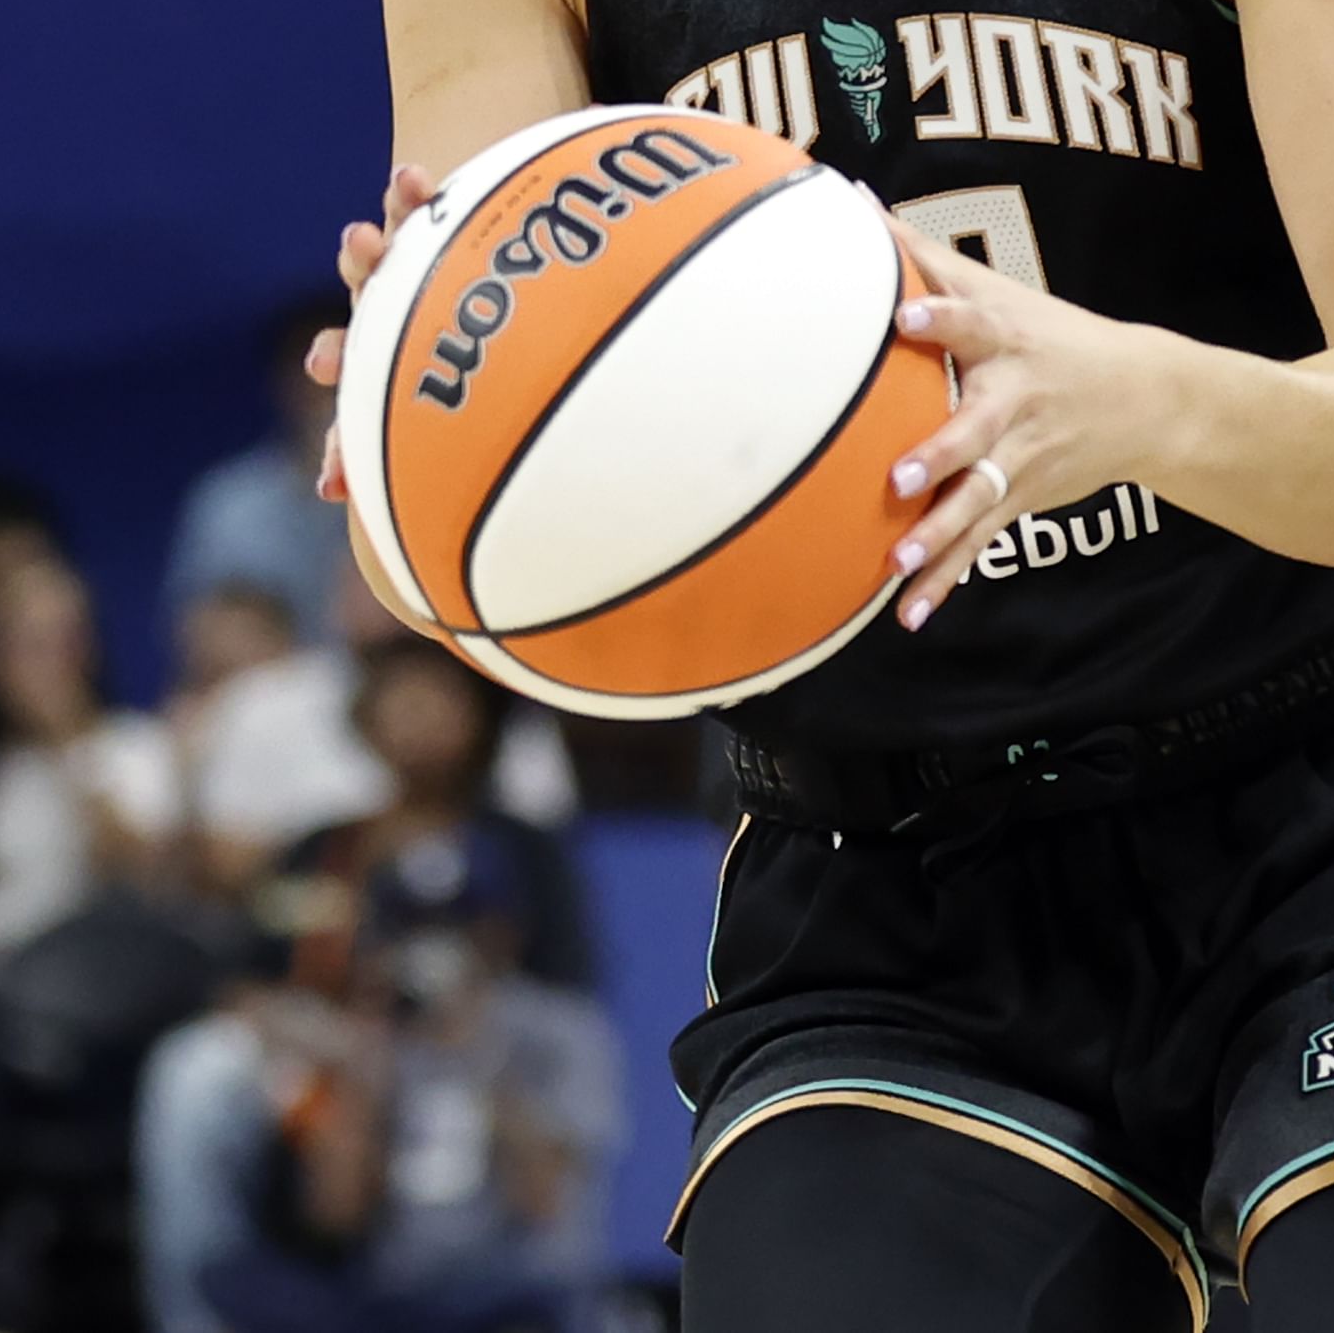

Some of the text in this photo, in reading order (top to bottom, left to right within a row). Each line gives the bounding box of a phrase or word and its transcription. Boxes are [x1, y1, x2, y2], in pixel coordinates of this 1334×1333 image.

[895, 11, 1204, 171] YORK
[415, 126, 741, 413] Wilson
[957, 484, 1161, 585] ebull
